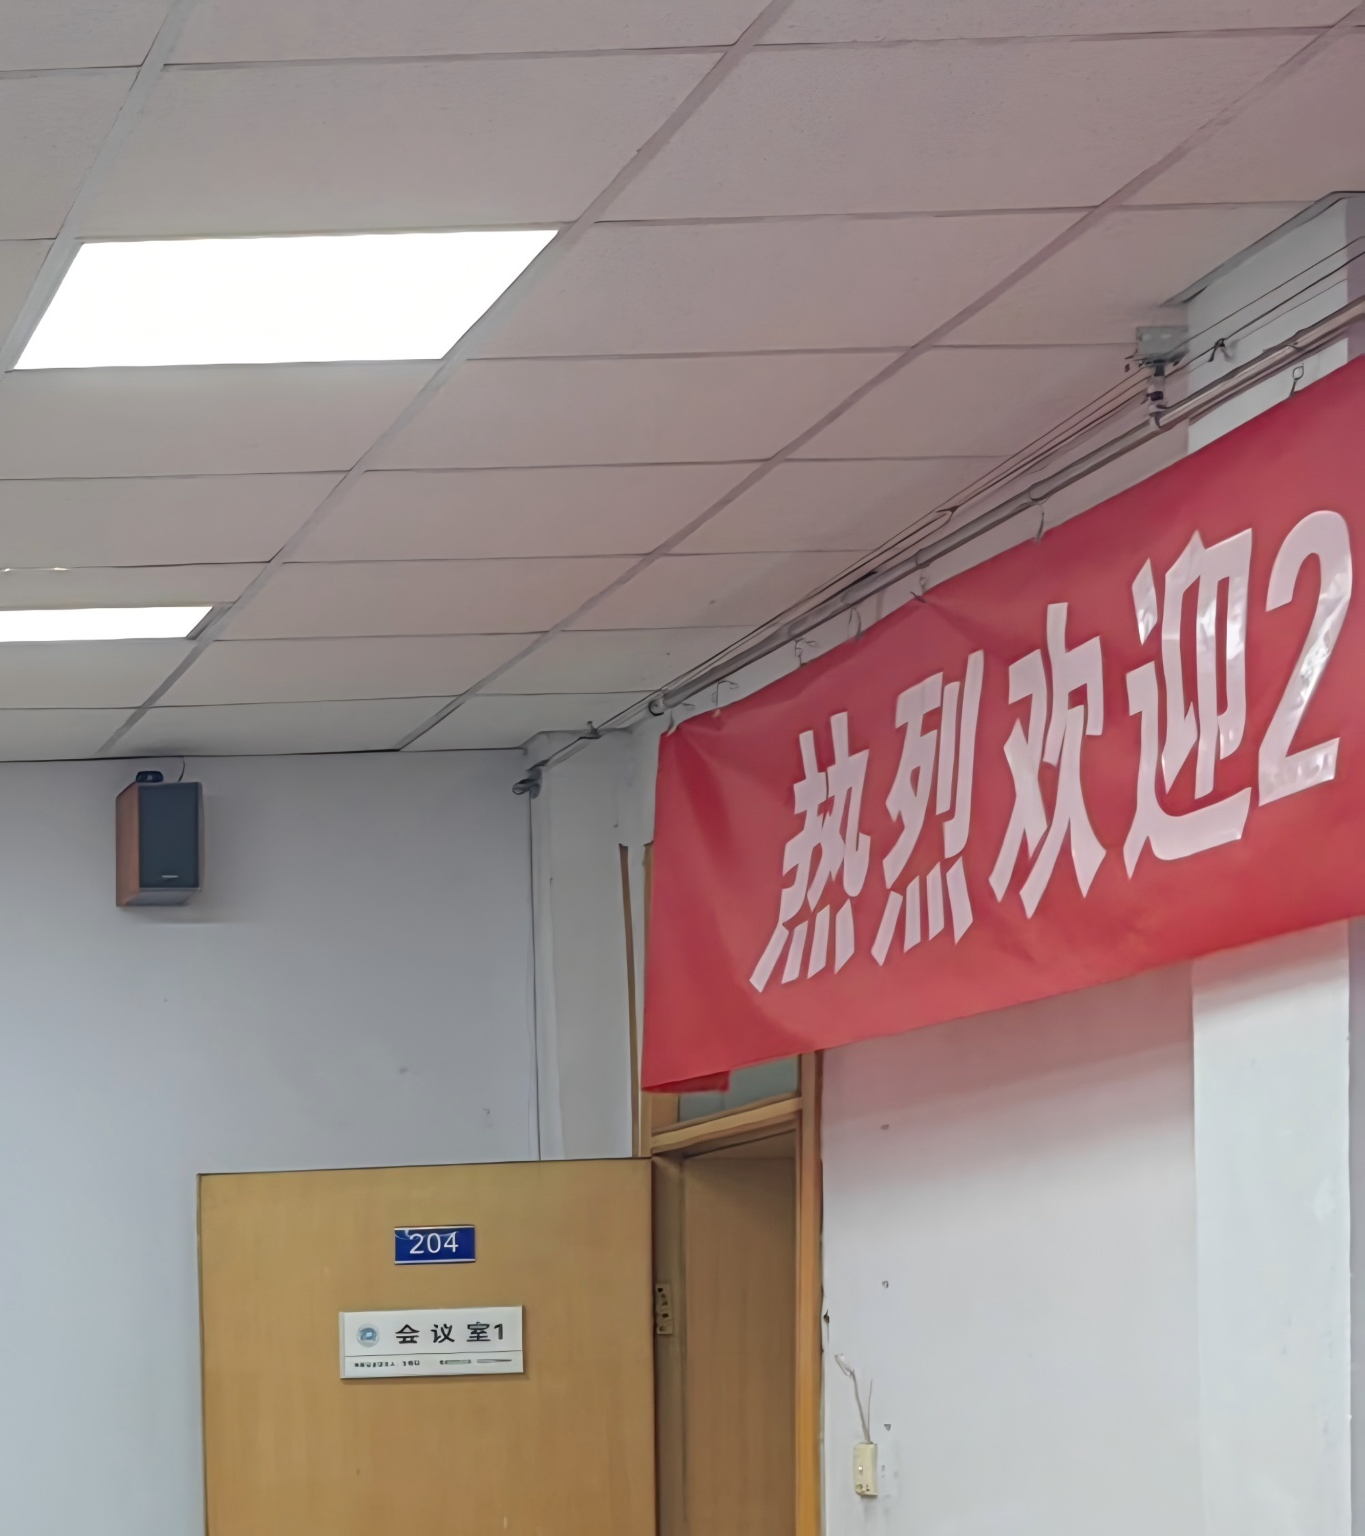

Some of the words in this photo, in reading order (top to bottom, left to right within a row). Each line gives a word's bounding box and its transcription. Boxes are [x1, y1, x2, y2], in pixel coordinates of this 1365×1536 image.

[748, 509, 1354, 993] 热烈欢迎2
[408, 1231, 460, 1255] 204
